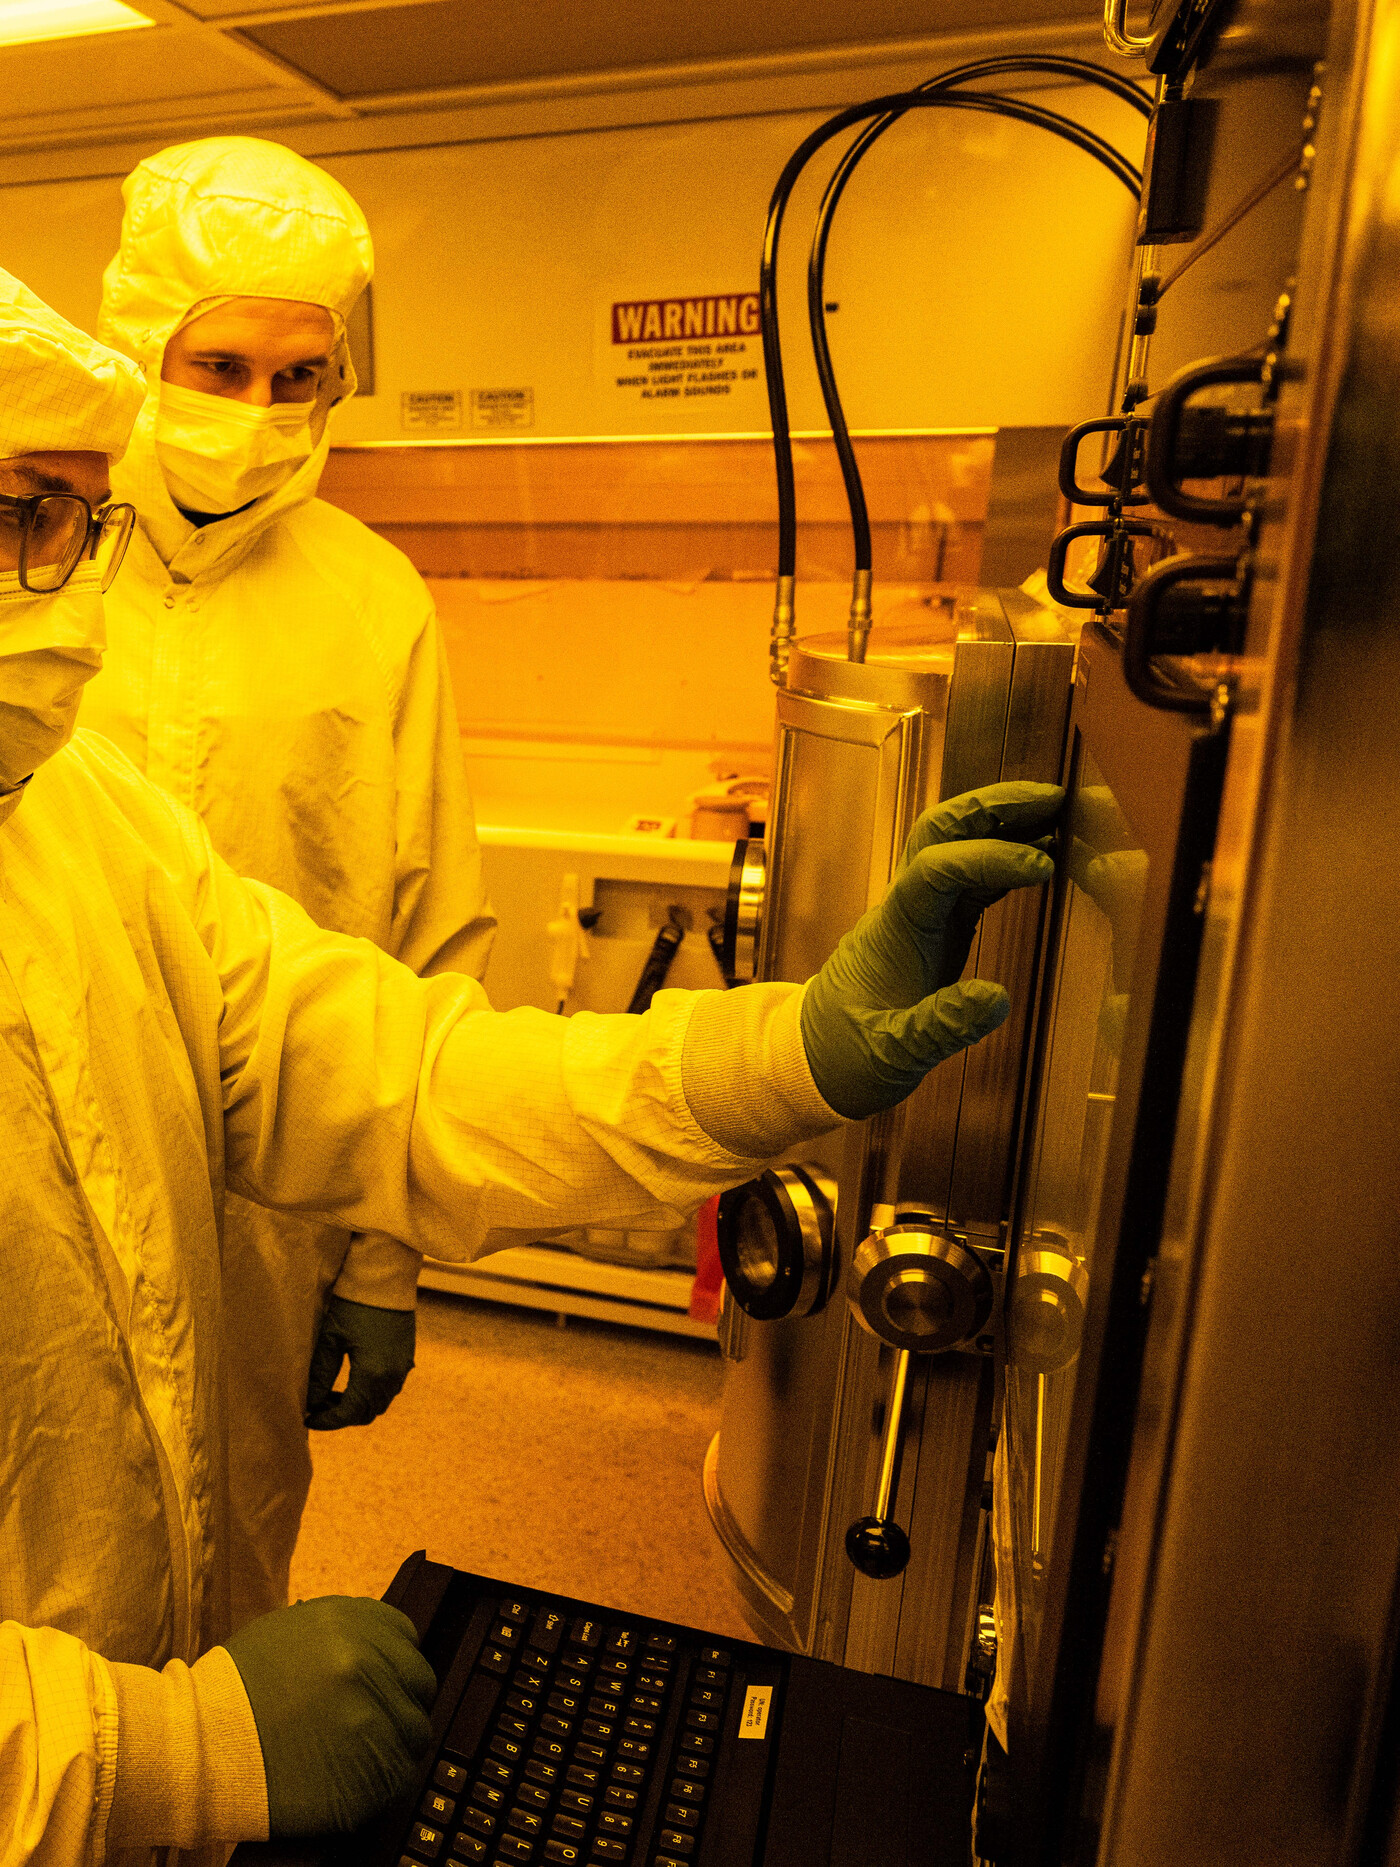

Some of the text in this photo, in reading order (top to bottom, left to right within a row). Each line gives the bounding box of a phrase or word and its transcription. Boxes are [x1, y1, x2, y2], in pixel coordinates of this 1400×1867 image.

[617, 295, 760, 341] WARNING
[628, 342, 747, 359] EVACUATE THIS AREA
[648, 358, 724, 371] IMMEDIATELY
[616, 369, 759, 387] WHEN LIGHT FLASHES OR
[641, 384, 731, 399] ALARM SOUNDS
[616, 1661, 627, 1670] Q
[707, 1670, 716, 1679] F1
[610, 1681, 622, 1691] W
[702, 1691, 712, 1700] F2
[604, 1703, 616, 1712] E
[745, 1696, 758, 1728] Password: 123
[698, 1713, 707, 1722] F3
[755, 1706, 764, 1727] operator
[599, 1725, 611, 1734] R
[694, 1736, 703, 1745] F4
[474, 1656, 548, 1851] Z X C V B N M < >
[517, 1657, 588, 1849] A S D F G H J K L
[592, 1750, 604, 1758] T
[689, 1759, 698, 1768] F5
[583, 1773, 596, 1781] Y
[683, 1784, 693, 1793] F6
[577, 1797, 590, 1807] U
[677, 1808, 688, 1818] F7
[672, 1833, 682, 1844] F8
[562, 1848, 576, 1858] O
